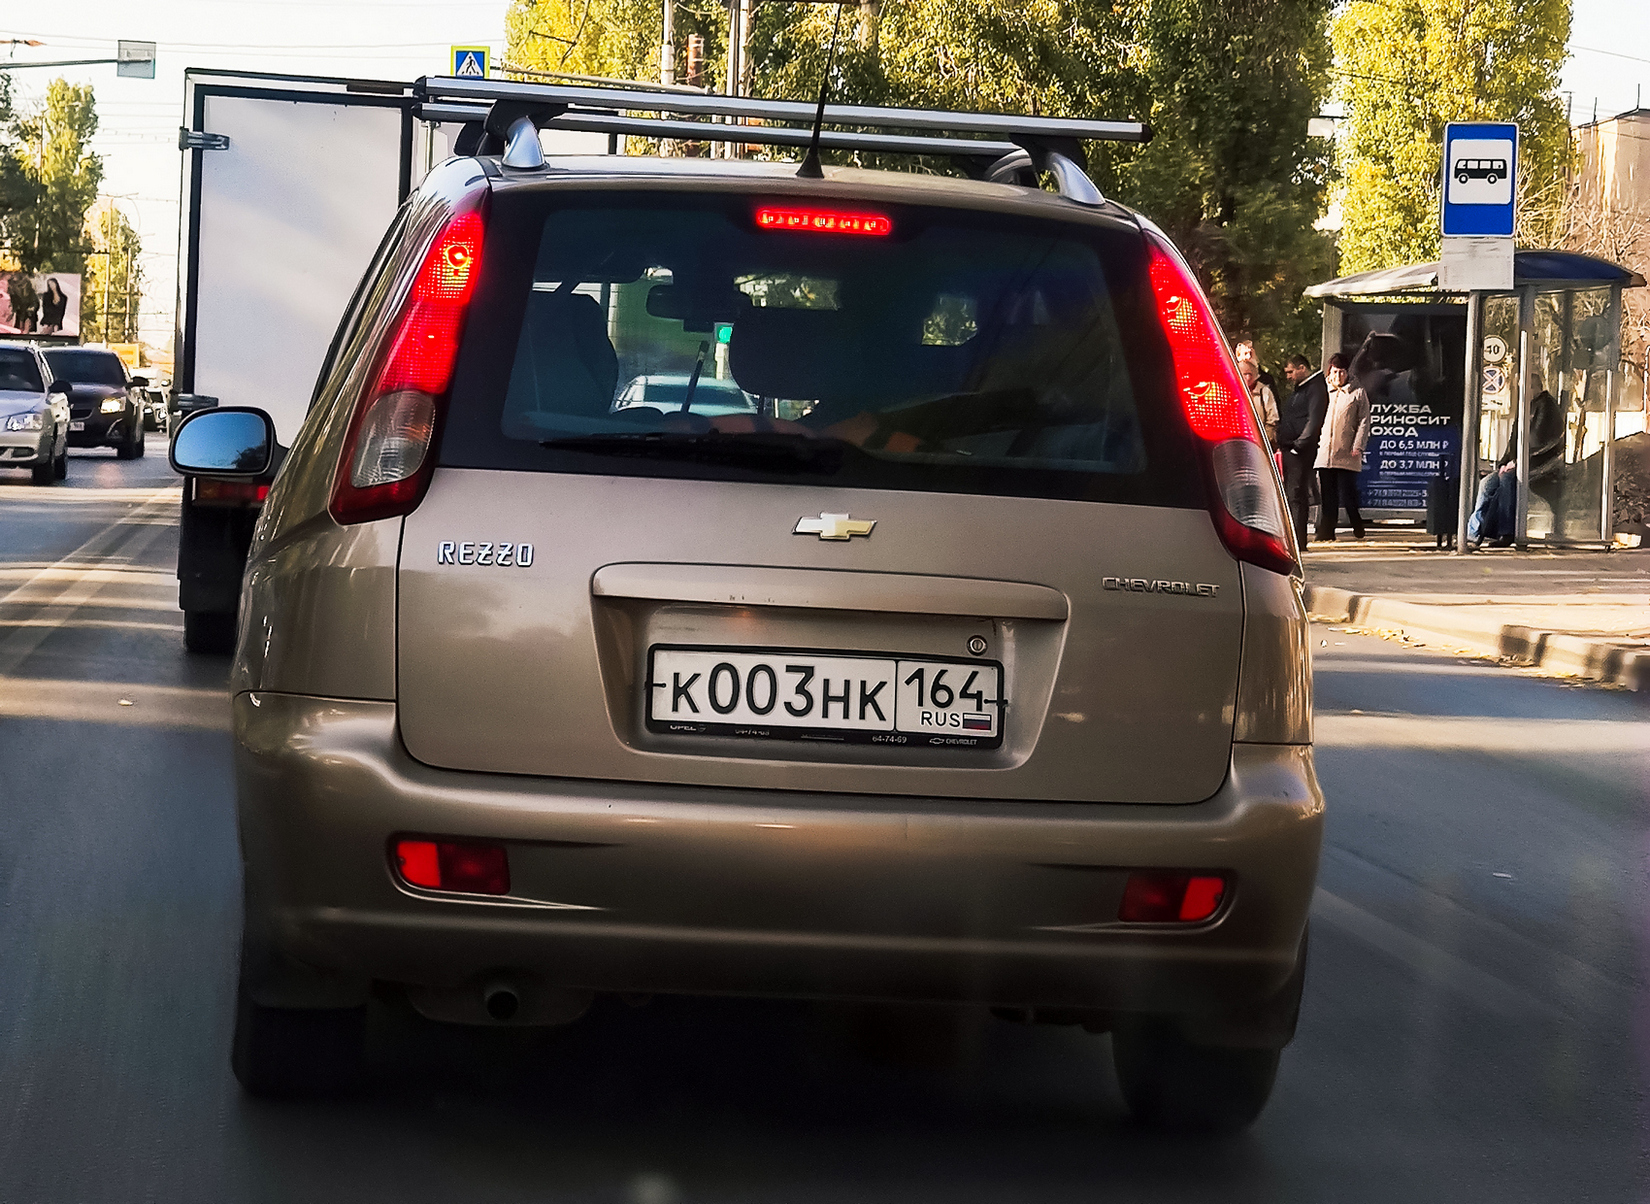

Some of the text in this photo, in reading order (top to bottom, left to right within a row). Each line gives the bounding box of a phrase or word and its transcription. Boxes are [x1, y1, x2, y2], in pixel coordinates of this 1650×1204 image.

[1370, 404, 1432, 414] ЛУЖБА
[1370, 415, 1451, 425] РИНОСИТ
[1367, 426, 1419, 437] ОХОД
[1380, 440, 1397, 450] ДО
[1398, 440, 1415, 450] 6,5
[1416, 441, 1441, 450] МЛН
[1380, 460, 1397, 470] ДО
[1399, 460, 1414, 470] 3,7
[1415, 461, 1440, 469] МЛН
[437, 540, 534, 567] REZZO
[1102, 577, 1221, 598] CHEVROLET
[903, 667, 987, 712] 164
[920, 712, 961, 728] RUS
